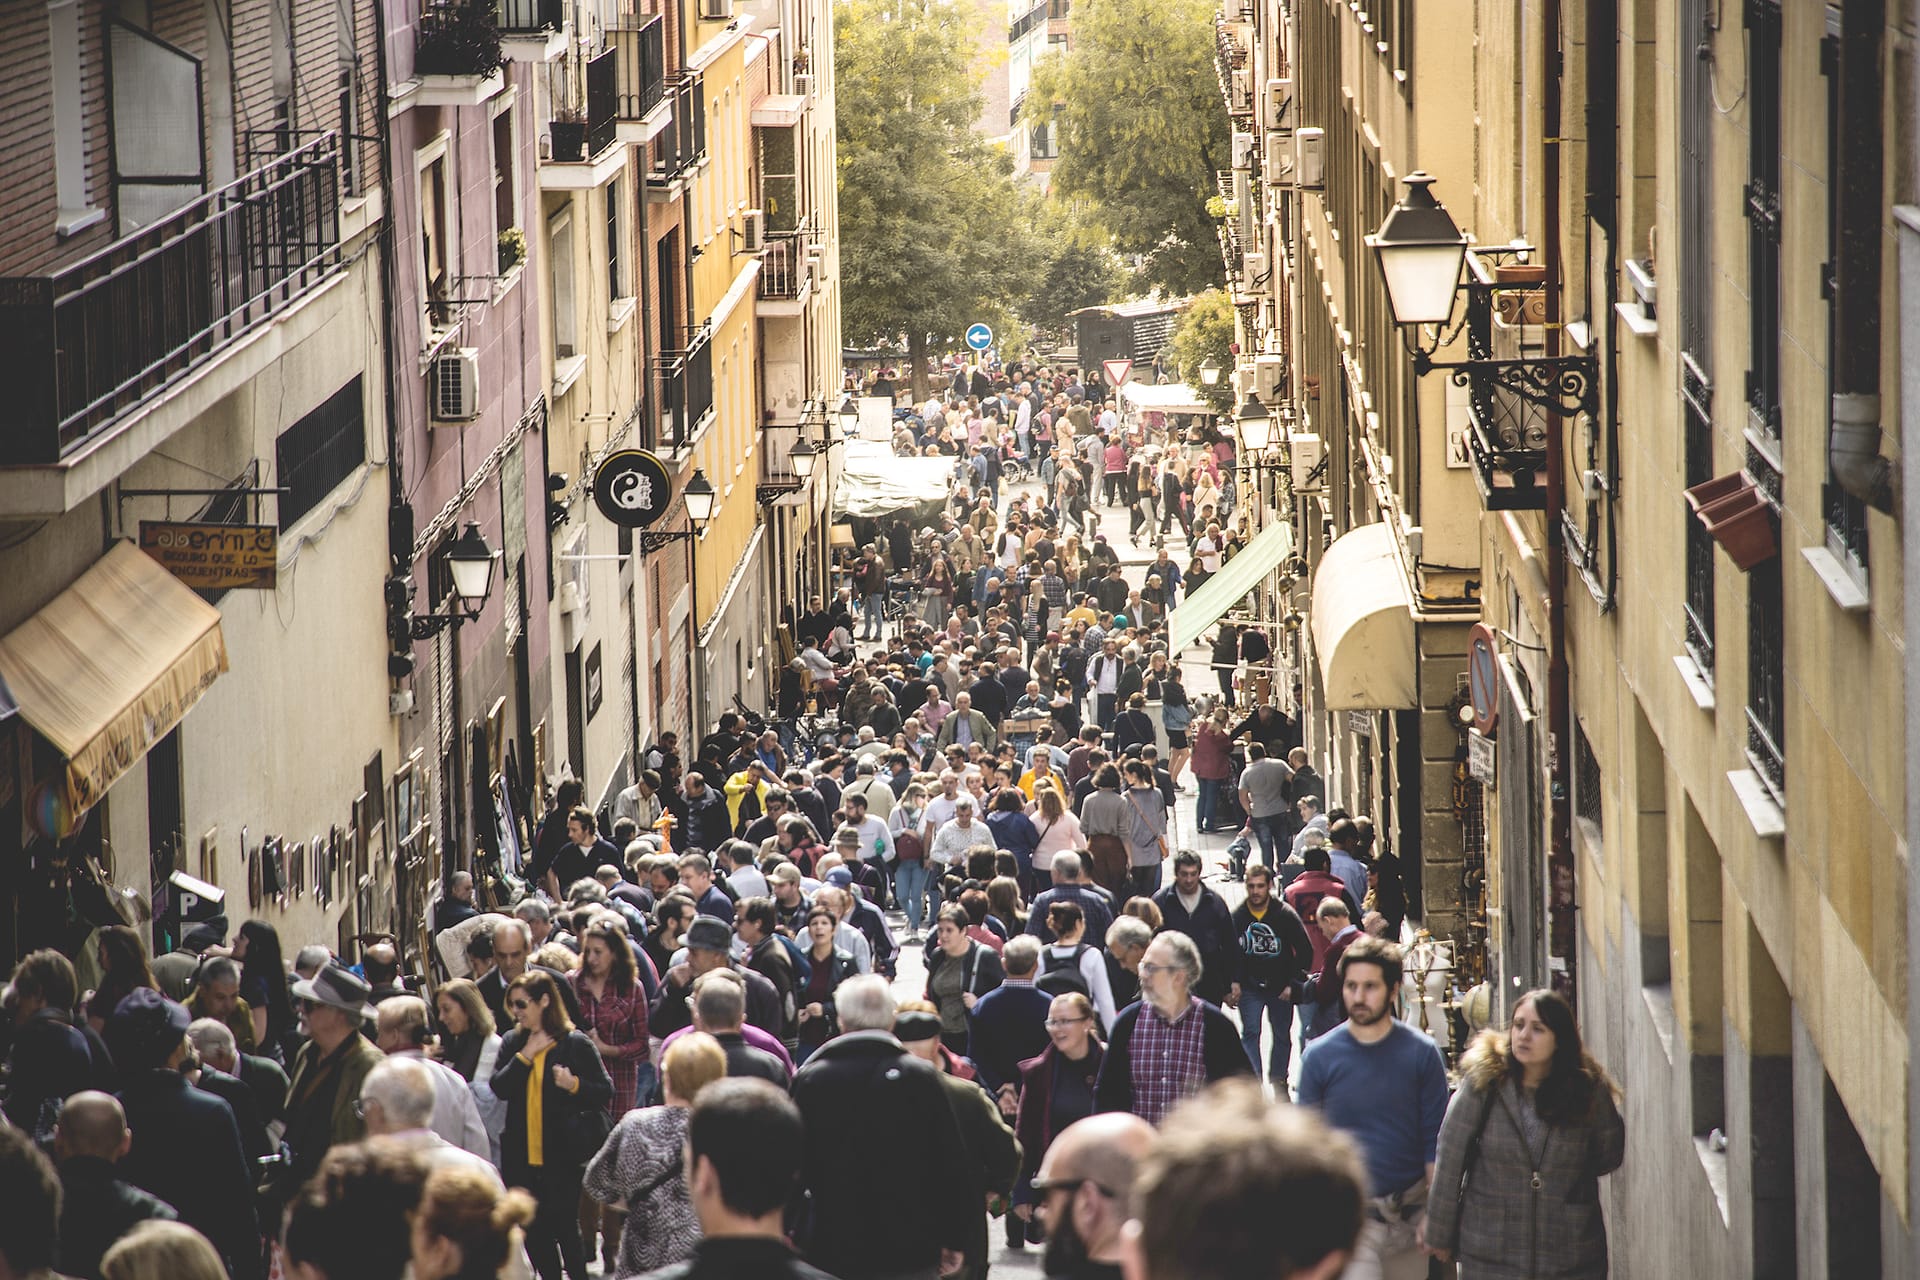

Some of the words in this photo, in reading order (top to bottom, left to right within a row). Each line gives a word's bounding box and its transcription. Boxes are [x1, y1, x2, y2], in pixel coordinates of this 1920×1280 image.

[212, 552, 235, 564] QUE
[243, 554, 258, 565] LO
[170, 565, 249, 578] ENCUENTRAS
[180, 892, 199, 916] P
